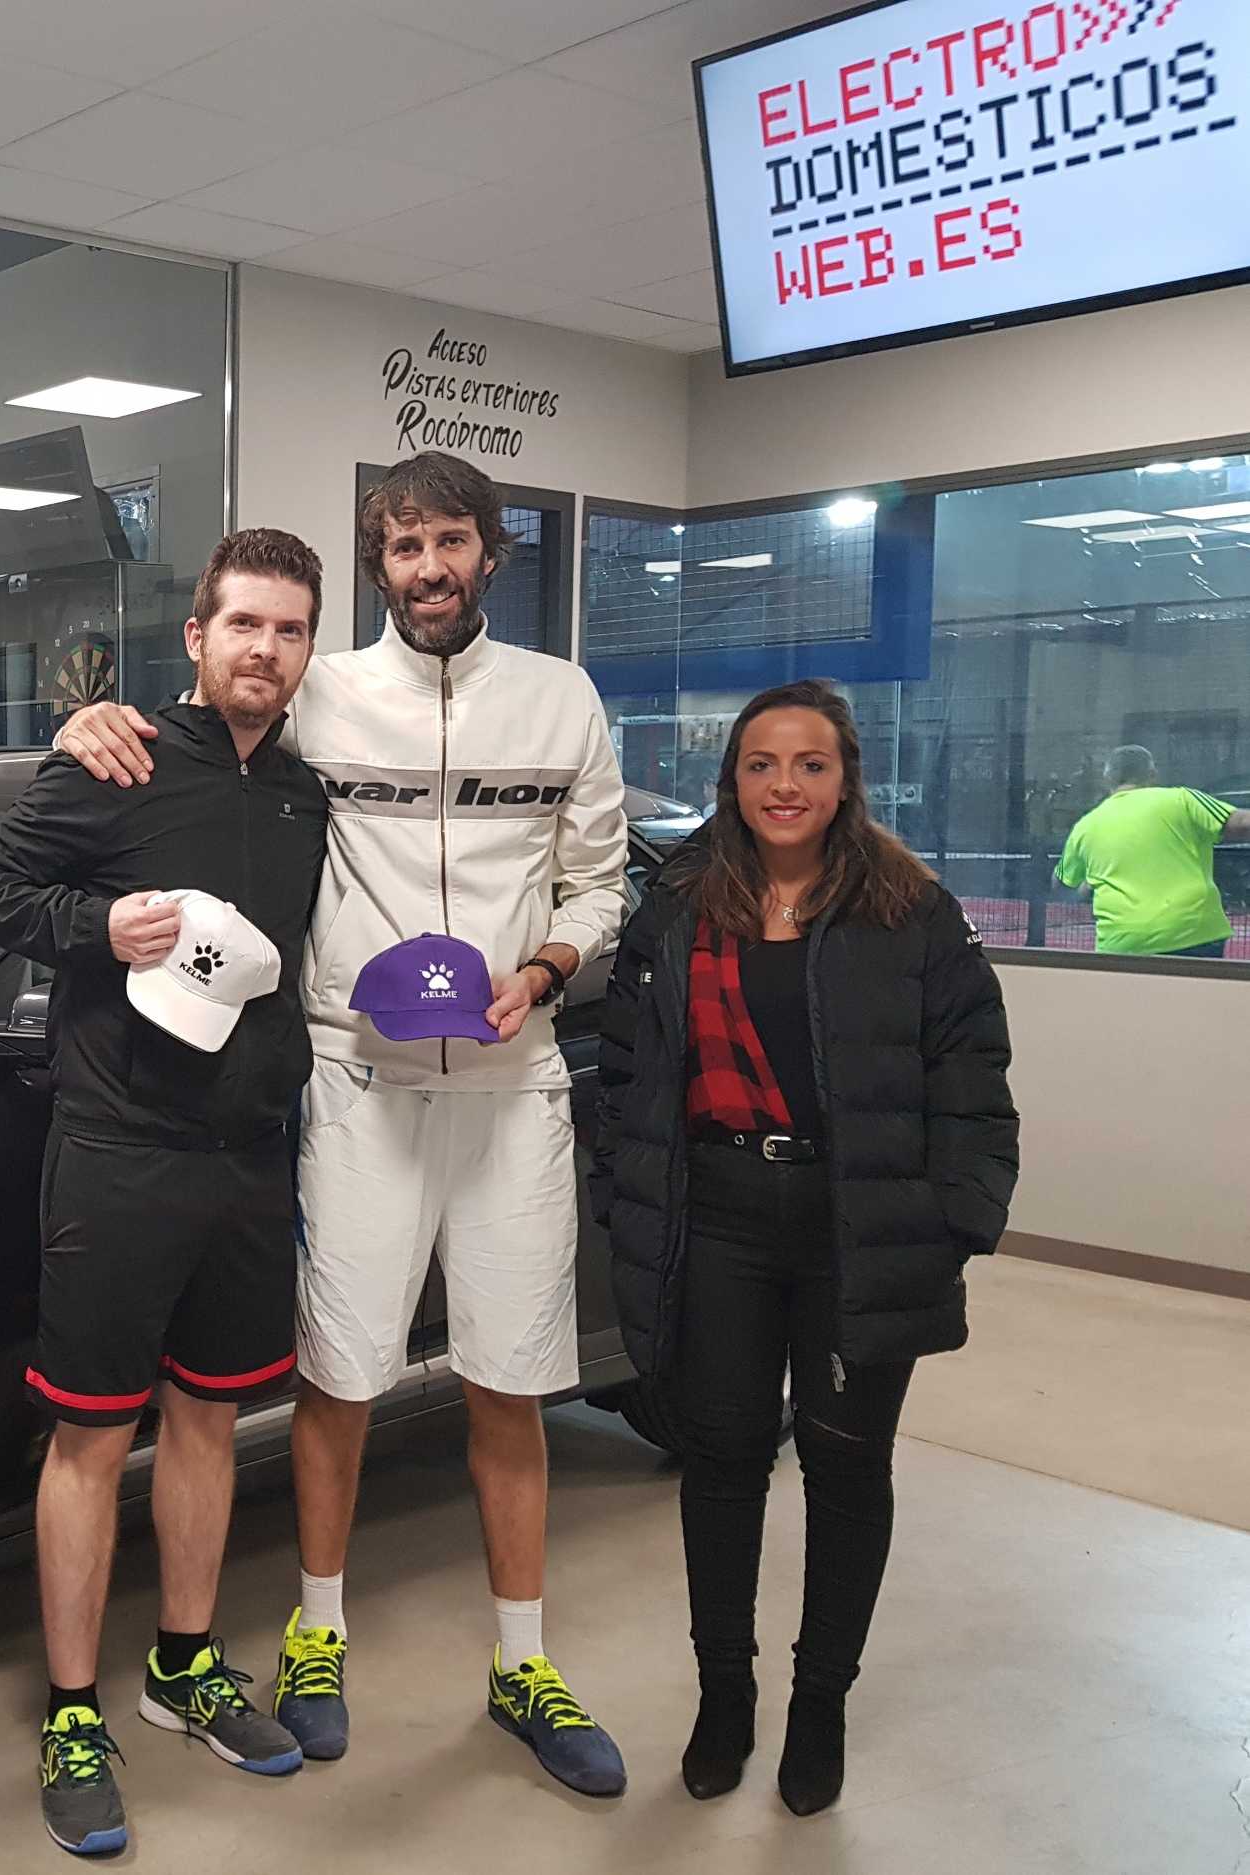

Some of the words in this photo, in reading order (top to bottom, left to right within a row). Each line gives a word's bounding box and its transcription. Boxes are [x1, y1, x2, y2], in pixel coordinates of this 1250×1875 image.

[758, 4, 1066, 147] ELECTRO
[766, 41, 1216, 216] DOMESTICOS
[774, 198, 1022, 304] WEB.ES
[179, 962, 212, 987] KELME
[421, 990, 458, 999] KELME
